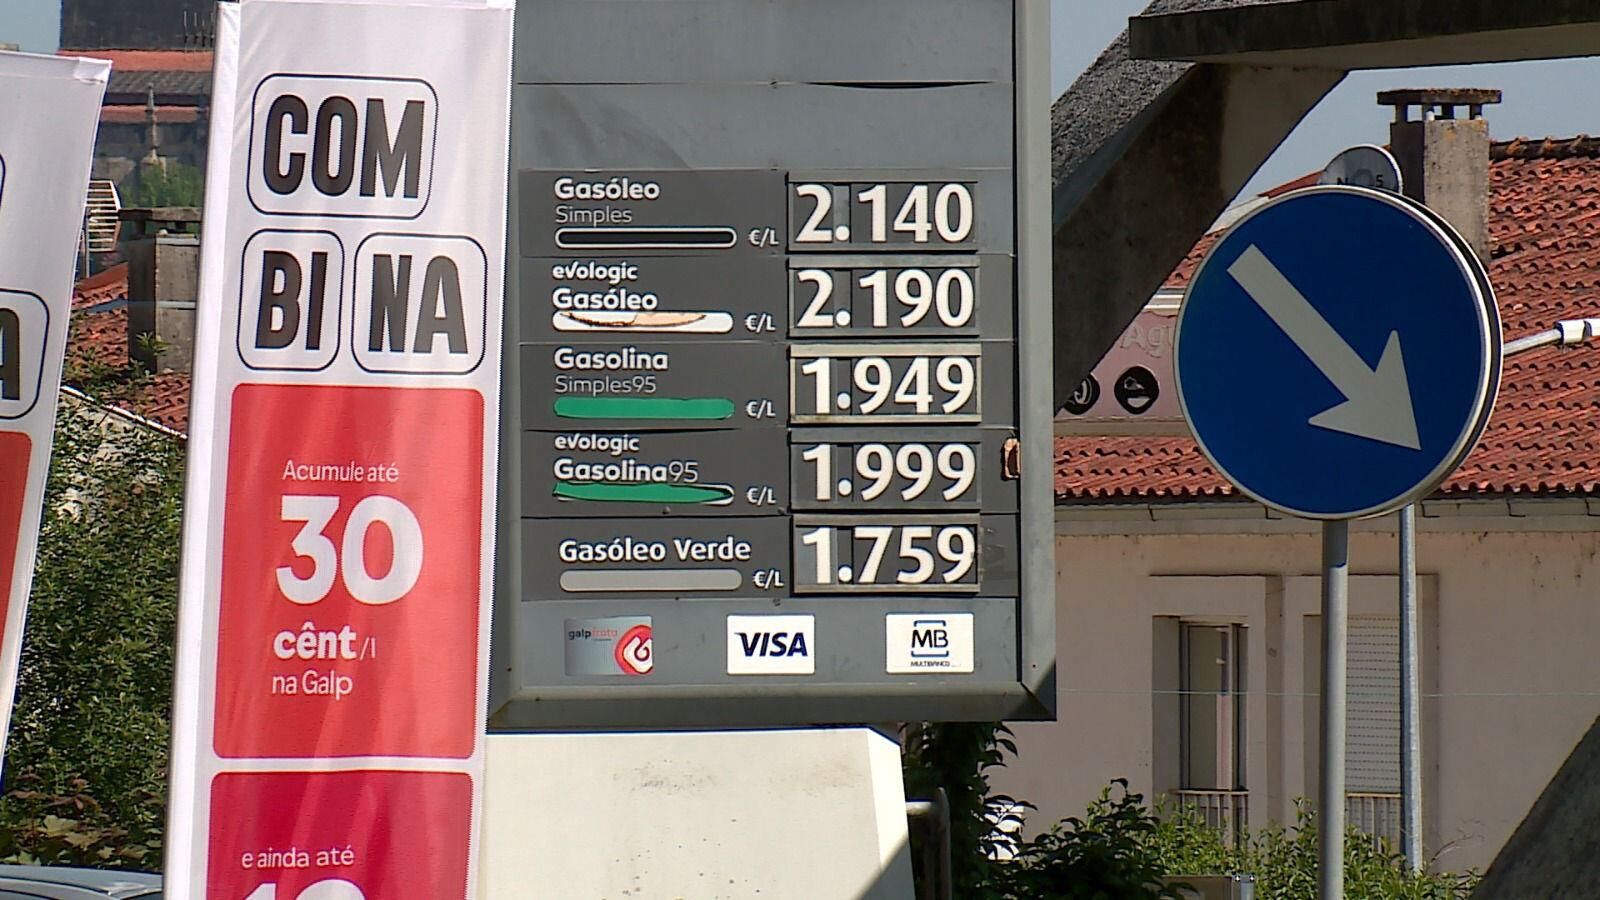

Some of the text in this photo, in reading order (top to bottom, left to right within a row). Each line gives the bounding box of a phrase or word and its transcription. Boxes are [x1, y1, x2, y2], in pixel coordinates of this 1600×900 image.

[263, 94, 425, 199] COM
[554, 176, 661, 200] Gasóleo
[555, 205, 633, 226] Simples
[796, 184, 974, 242] 2.140
[748, 228, 780, 247] €/L
[552, 286, 659, 311] Gasóleo
[797, 268, 975, 328] 2.190
[745, 314, 777, 333] €/L
[554, 346, 669, 371] Gasolina
[555, 374, 657, 397] Simples95
[802, 356, 975, 414] 1.949
[745, 400, 777, 419] €/L
[282, 459, 400, 483] Acumule até
[802, 443, 977, 501] 1.999
[746, 486, 777, 506] €/L
[275, 495, 425, 606] 30
[559, 537, 752, 562] Gasóleo Verde
[802, 525, 977, 584] 1.759
[752, 570, 784, 589] €/L
[735, 631, 808, 658] VISA
[911, 629, 949, 649] MB
[272, 669, 353, 701] na Galp
[241, 845, 355, 869] e ainda até
